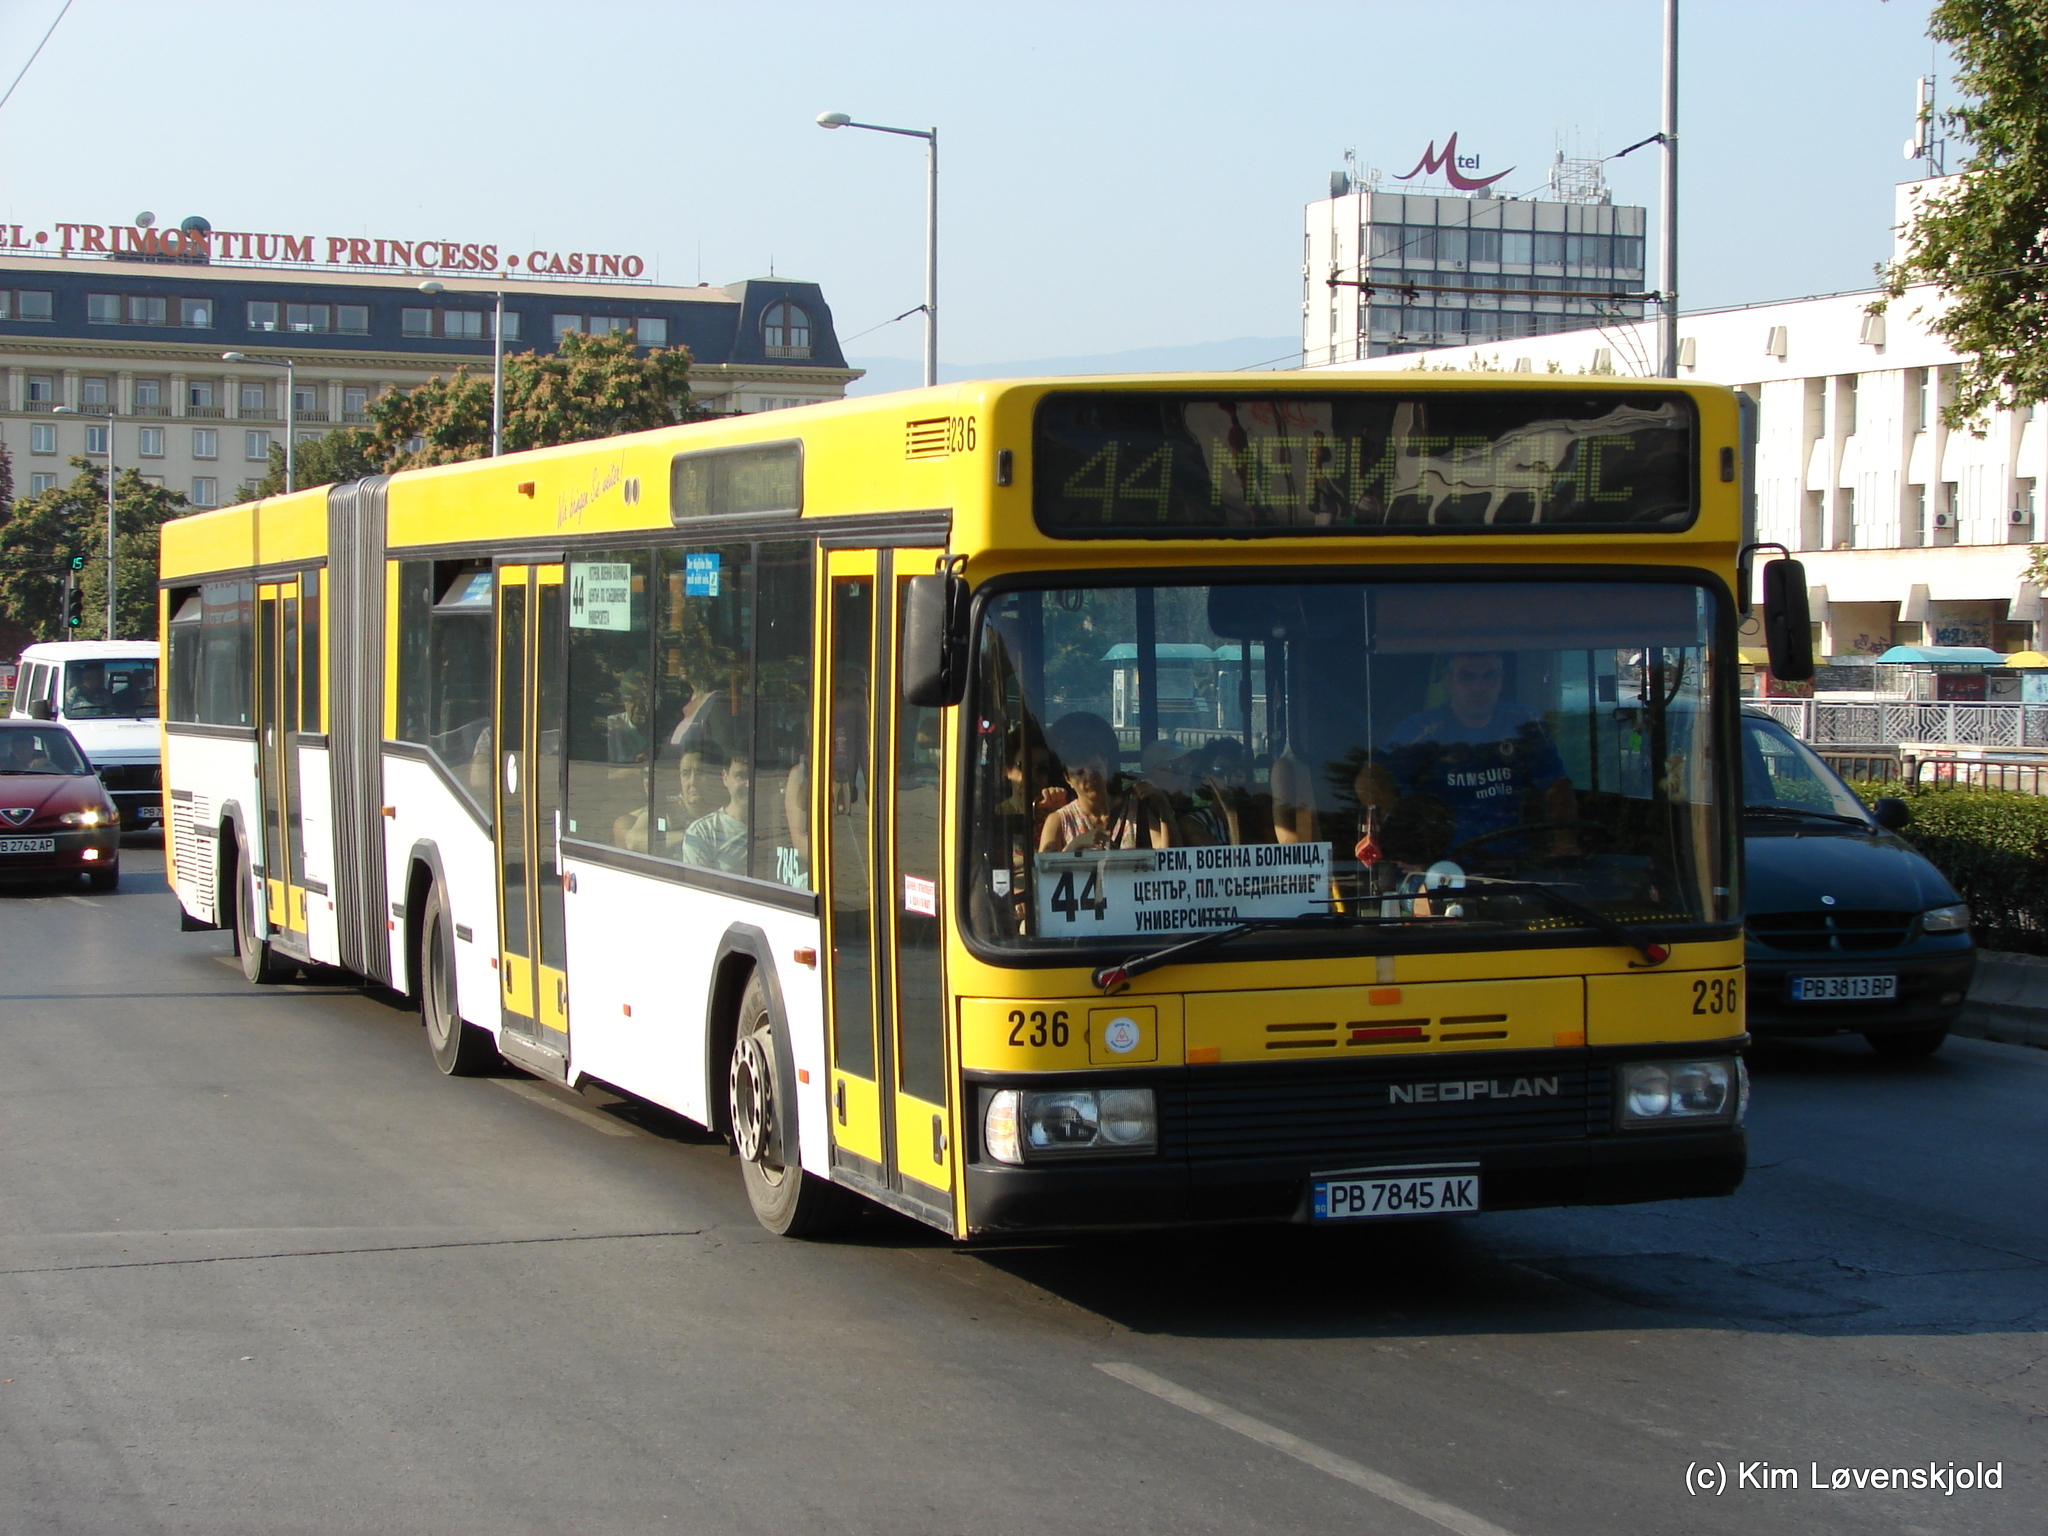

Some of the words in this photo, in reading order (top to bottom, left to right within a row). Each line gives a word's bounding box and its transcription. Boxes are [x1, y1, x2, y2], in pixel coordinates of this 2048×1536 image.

[56, 223, 315, 262] TRIMONTIUM
[326, 236, 498, 271] PRINCESS
[527, 250, 644, 277] CASINO
[950, 415, 976, 452] 236
[1062, 440, 1173, 523] 44
[72, 556, 83, 570] 15
[573, 575, 584, 614] 44
[143, 808, 155, 817] PB
[156, 808, 164, 817] 7
[0, 841, 7, 852] B
[11, 841, 37, 851] 2762
[39, 840, 52, 851] AP
[1196, 848, 1251, 870] ВОЕННА
[1255, 844, 1325, 869] БОЛНИЦА,
[776, 846, 799, 886] 7845
[1051, 867, 1108, 923] 44
[1134, 878, 1191, 903] ЦЕНТЪР,
[1134, 908, 1239, 931] УНИВЕРСИТЕТА
[1693, 978, 1736, 1015] 236
[1803, 980, 1825, 997] PB
[1828, 979, 1868, 997] 3813
[1872, 978, 1893, 996] BP
[1008, 1010, 1069, 1047] 236
[1389, 1077, 1558, 1104] NEOPLAN
[1315, 1204, 1326, 1213] BG
[1331, 1185, 1365, 1213] PB
[1372, 1182, 1434, 1211] 7845
[1441, 1180, 1473, 1208] AK
